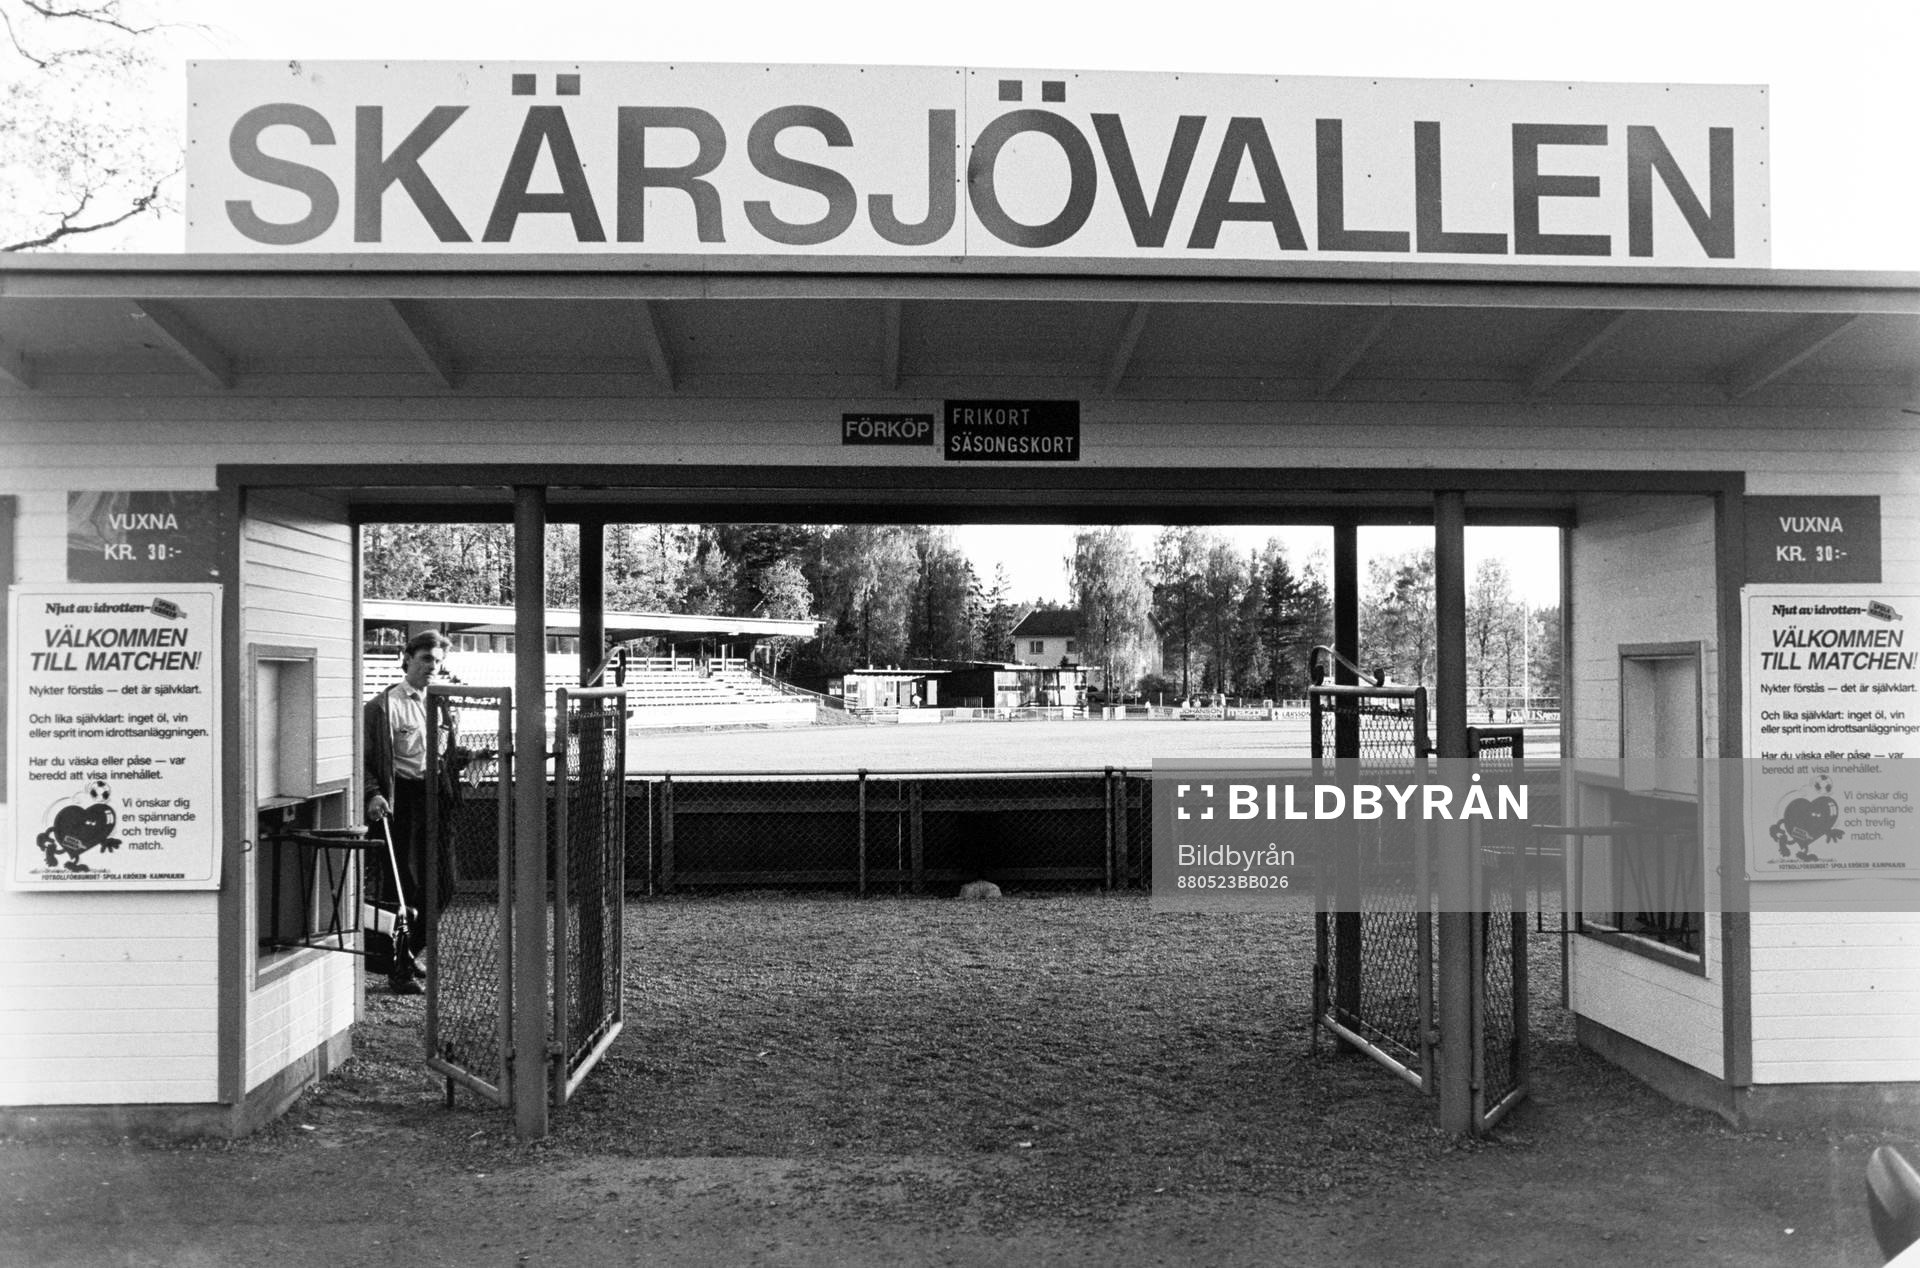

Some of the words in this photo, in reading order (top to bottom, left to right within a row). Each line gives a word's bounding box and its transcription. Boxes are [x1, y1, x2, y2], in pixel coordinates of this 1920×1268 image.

[225, 73, 1735, 259] SKÄRSJÖVALLEN
[953, 408, 1030, 425] FRIKORT
[846, 417, 929, 438] FÖRKÖP
[951, 432, 1074, 453] SÄSONGSKORT
[109, 513, 178, 530] VUXNA
[1779, 517, 1844, 532] VUXNA
[104, 544, 136, 560] KR.
[1776, 546, 1806, 561] KR.
[45, 603, 75, 615] Njut
[77, 605, 93, 614] av
[1772, 605, 1797, 617] Njut
[1799, 606, 1814, 615] av
[45, 624, 188, 648] VÄLKOMMEN
[1772, 625, 1904, 648] VÄLKOMMEN
[30, 652, 77, 671] TILL
[85, 651, 202, 671] MATCHEN!
[1760, 652, 1801, 670] TILL
[1808, 652, 1918, 670] MATCHEN!
[29, 685, 63, 697] Nykter
[67, 684, 104, 695] förstås
[121, 685, 138, 695] det
[141, 685, 151, 695] är
[154, 685, 202, 697] självklart.
[1760, 684, 1791, 695] Nykter
[1794, 682, 1825, 693] förstås
[1841, 683, 1856, 693] det
[1859, 683, 1869, 693] är
[1872, 683, 1917, 694] självklart.
[29, 713, 51, 724] Och
[54, 713, 73, 724] lika
[76, 713, 125, 726] självklart:
[128, 713, 154, 726] inget
[157, 713, 169, 724] öl,
[172, 713, 188, 723] vin
[1761, 711, 1780, 720] Och
[1783, 711, 1799, 720] lika
[1801, 711, 1844, 722] självklart:
[1847, 711, 1872, 722] inget
[1875, 710, 1887, 720] öl,
[1890, 710, 1905, 719] vin
[29, 728, 51, 738] eller
[53, 728, 76, 740] sprit
[78, 728, 104, 737] inom
[105, 727, 209, 740] idrottsanläggningen.
[1761, 725, 1779, 733] eller
[1782, 725, 1801, 736] sprit
[1803, 725, 1825, 733] inom
[29, 757, 48, 766] Har
[51, 757, 65, 766] du
[69, 756, 99, 766] väska
[102, 756, 124, 766] eller
[127, 755, 152, 768] påse
[170, 757, 186, 766] var
[1761, 751, 1777, 761] Har
[1780, 751, 1792, 761] du
[1795, 751, 1821, 761] väska
[1824, 751, 1844, 761] eller
[1847, 750, 1871, 762] påse
[1888, 752, 1904, 760] var
[29, 770, 67, 780] beredd
[70, 770, 83, 780] att
[87, 770, 107, 780] visa
[110, 769, 163, 780] innehållet.
[1762, 765, 1794, 774] beredd
[1797, 765, 1809, 774] att
[1811, 764, 1830, 773] visa
[1832, 763, 1883, 773] innehållet.
[1844, 791, 1853, 800] Vi
[1856, 791, 1889, 800] önskar
[1892, 791, 1908, 802] dig
[122, 798, 132, 807] Vi
[135, 798, 171, 808] önskar
[173, 798, 190, 810] dig
[1844, 806, 1856, 814] en
[1859, 805, 1914, 816] spännande
[122, 813, 135, 822] en
[138, 812, 196, 824] spännande
[1844, 818, 1862, 827] och
[1865, 818, 1895, 829] trevlig
[122, 827, 141, 836] och
[145, 826, 177, 838] trevlig
[1851, 831, 1883, 840] match.
[128, 841, 164, 850] match.
